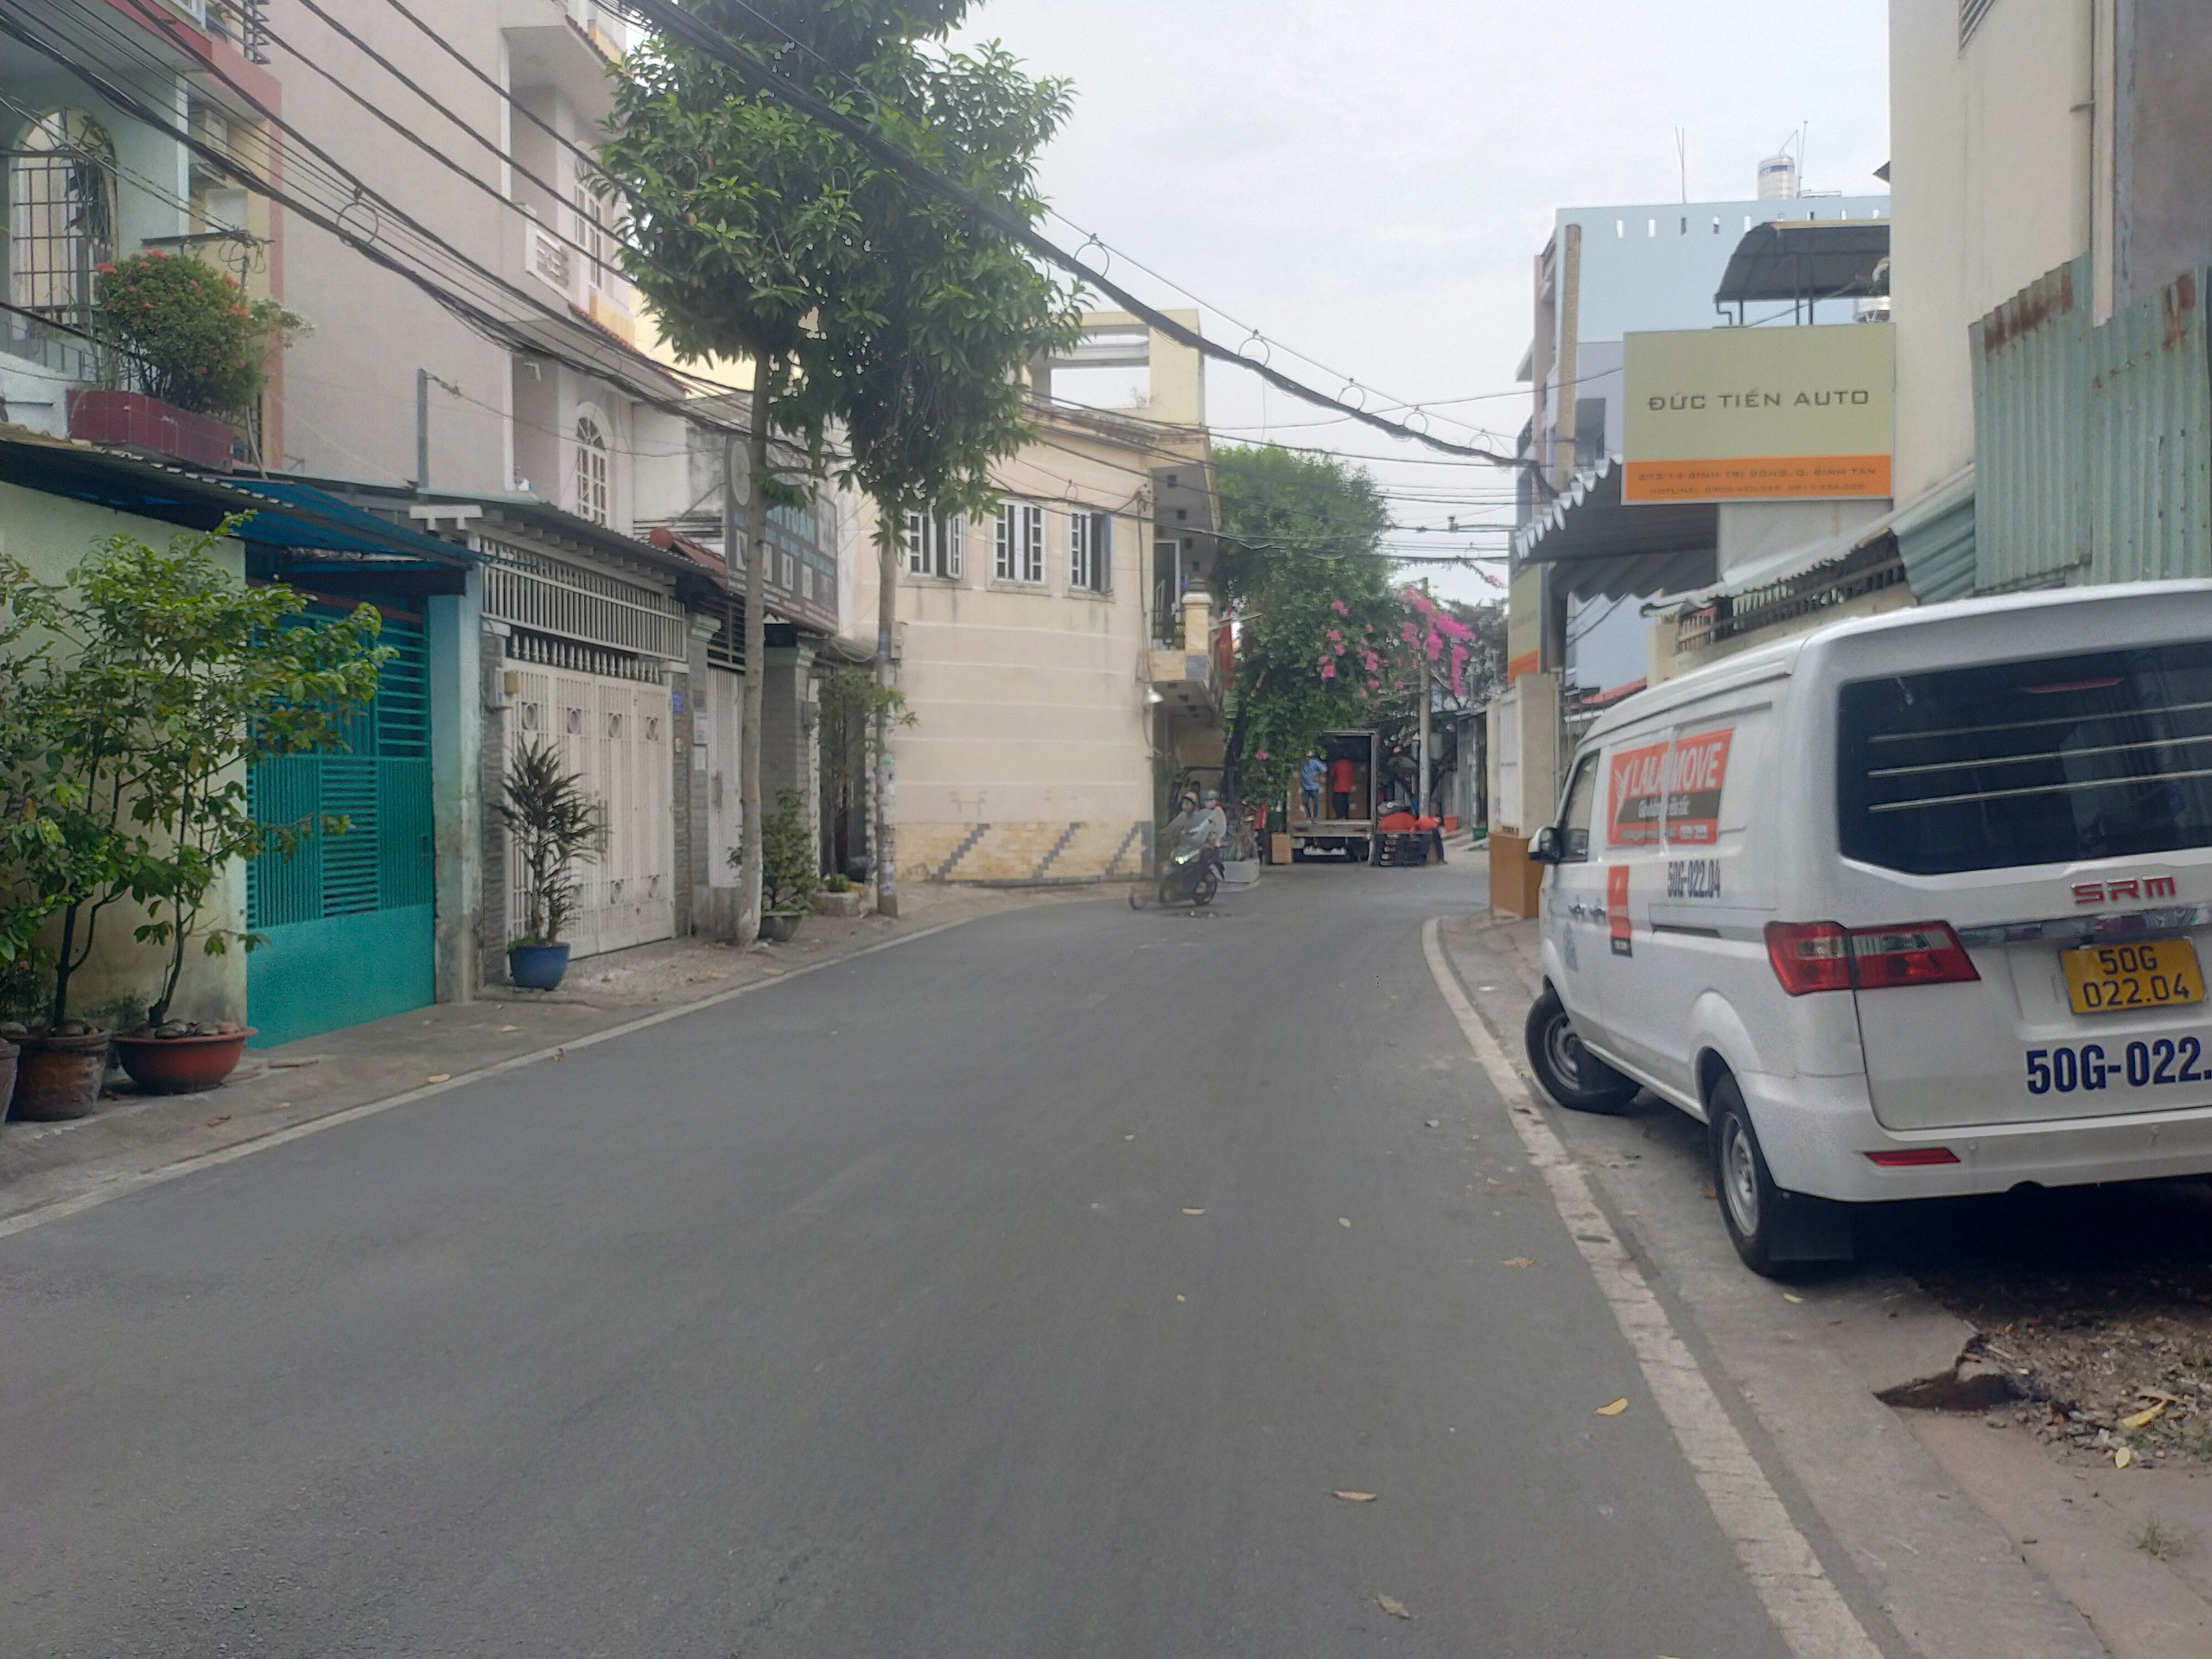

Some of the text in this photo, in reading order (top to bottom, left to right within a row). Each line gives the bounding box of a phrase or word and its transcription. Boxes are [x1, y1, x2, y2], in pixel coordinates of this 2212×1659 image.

[1648, 387, 1869, 411] ĐỨC TIẾN AUTO
[1667, 859, 1721, 899] 50G-022.04
[2071, 875, 2177, 905] SRM
[2099, 945, 2158, 976] 50G
[2082, 973, 2190, 1008] 022.04
